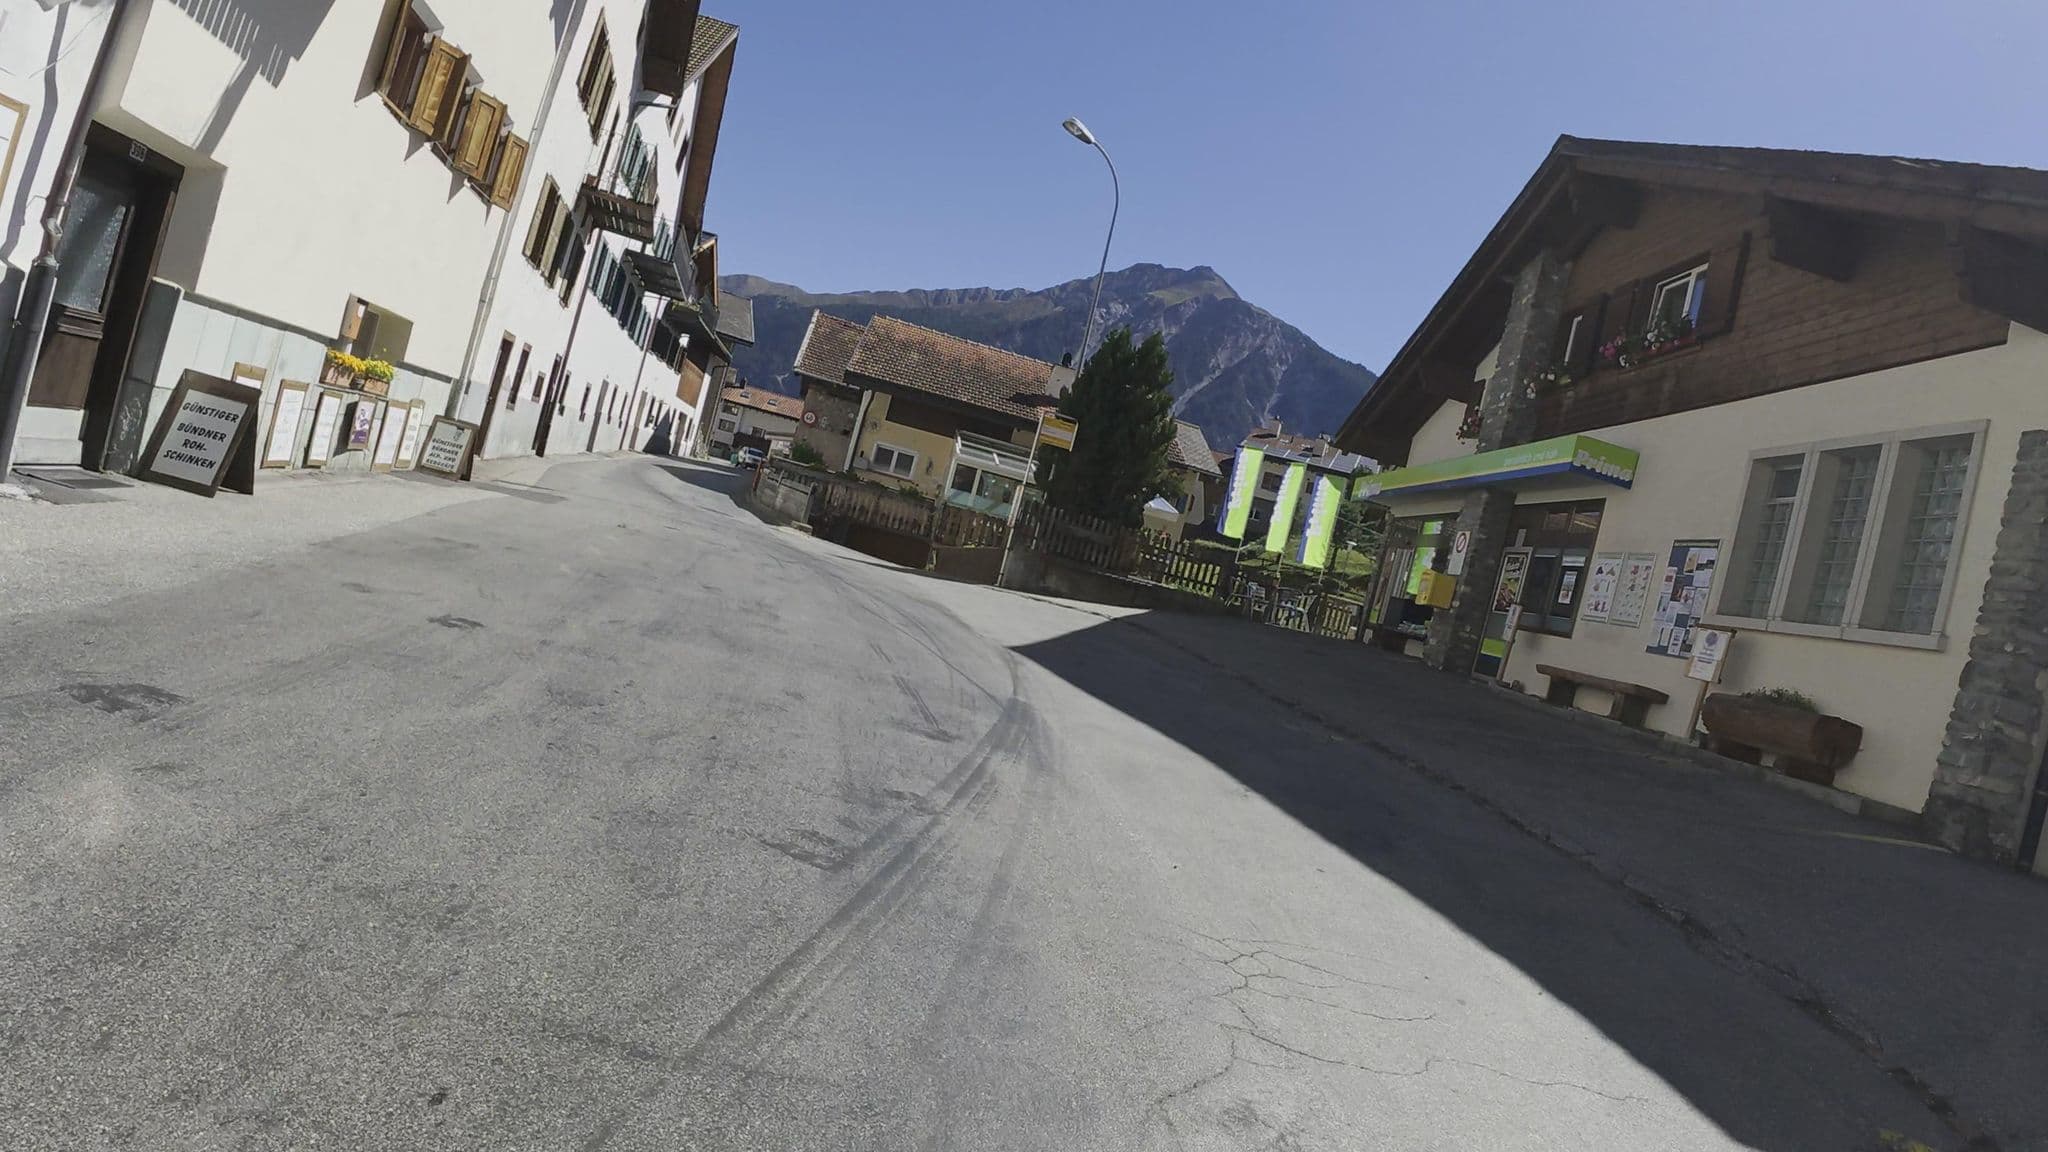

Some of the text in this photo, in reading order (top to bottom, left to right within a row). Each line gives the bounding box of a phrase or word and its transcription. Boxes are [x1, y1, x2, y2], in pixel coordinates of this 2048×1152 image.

[182, 402, 239, 424] GÜNSTIGER
[177, 423, 227, 443] BÜNDNER
[182, 438, 207, 452] ROH-
[163, 449, 216, 470] SCHINKEN
